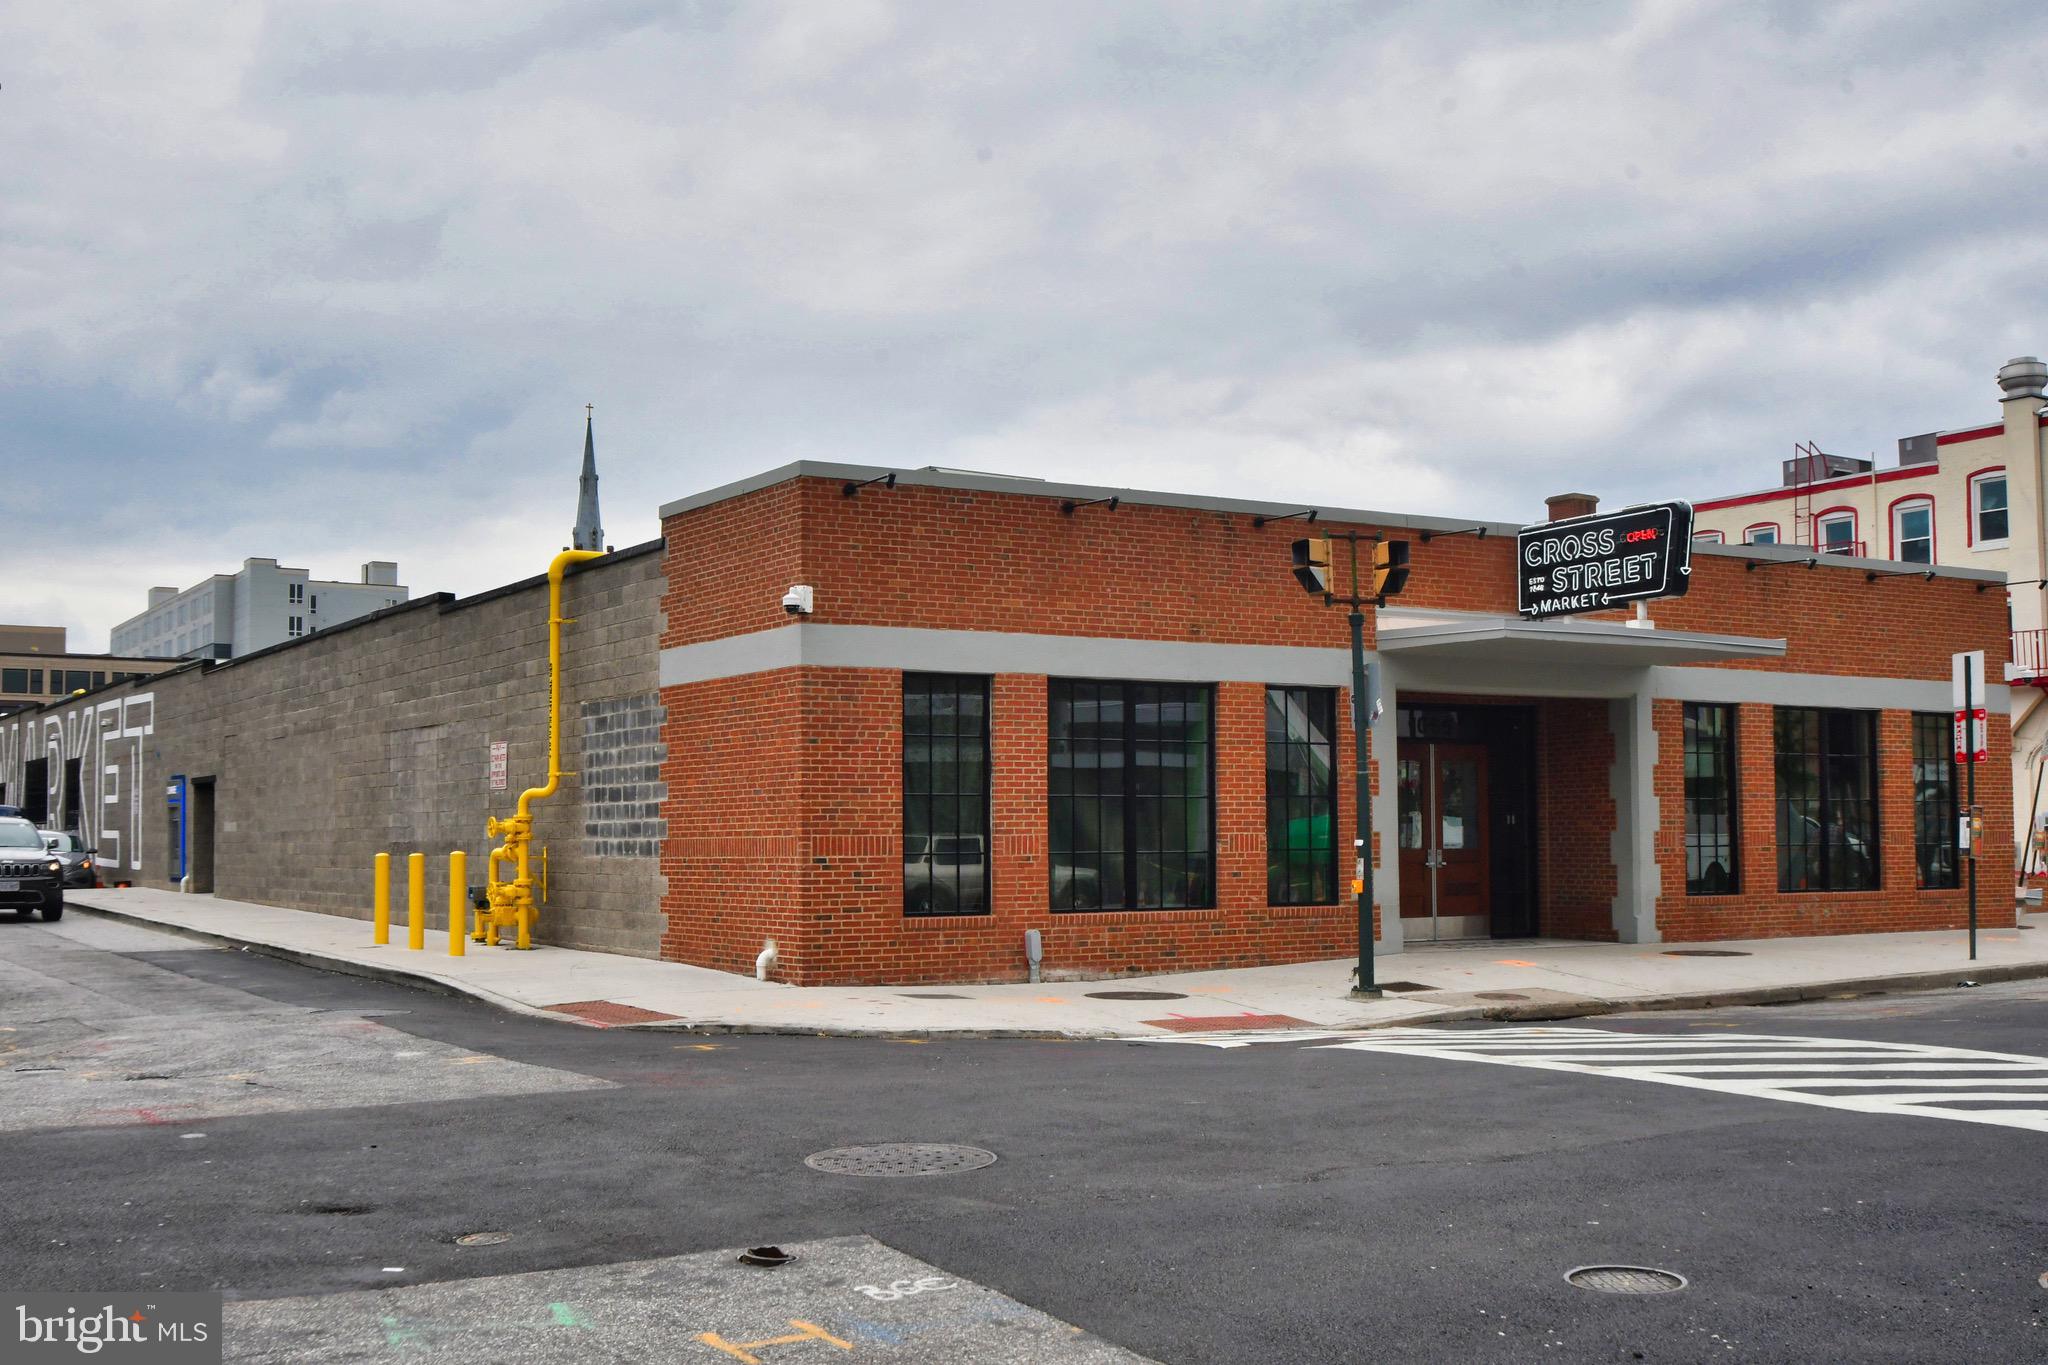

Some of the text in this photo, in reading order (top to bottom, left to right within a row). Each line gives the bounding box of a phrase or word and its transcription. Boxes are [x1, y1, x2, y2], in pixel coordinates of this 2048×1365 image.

[1525, 528, 1615, 567] CROSS
[1626, 528, 1658, 543] OPEN
[1551, 552, 1658, 593] STREET
[1539, 592, 1600, 613] MARKET
